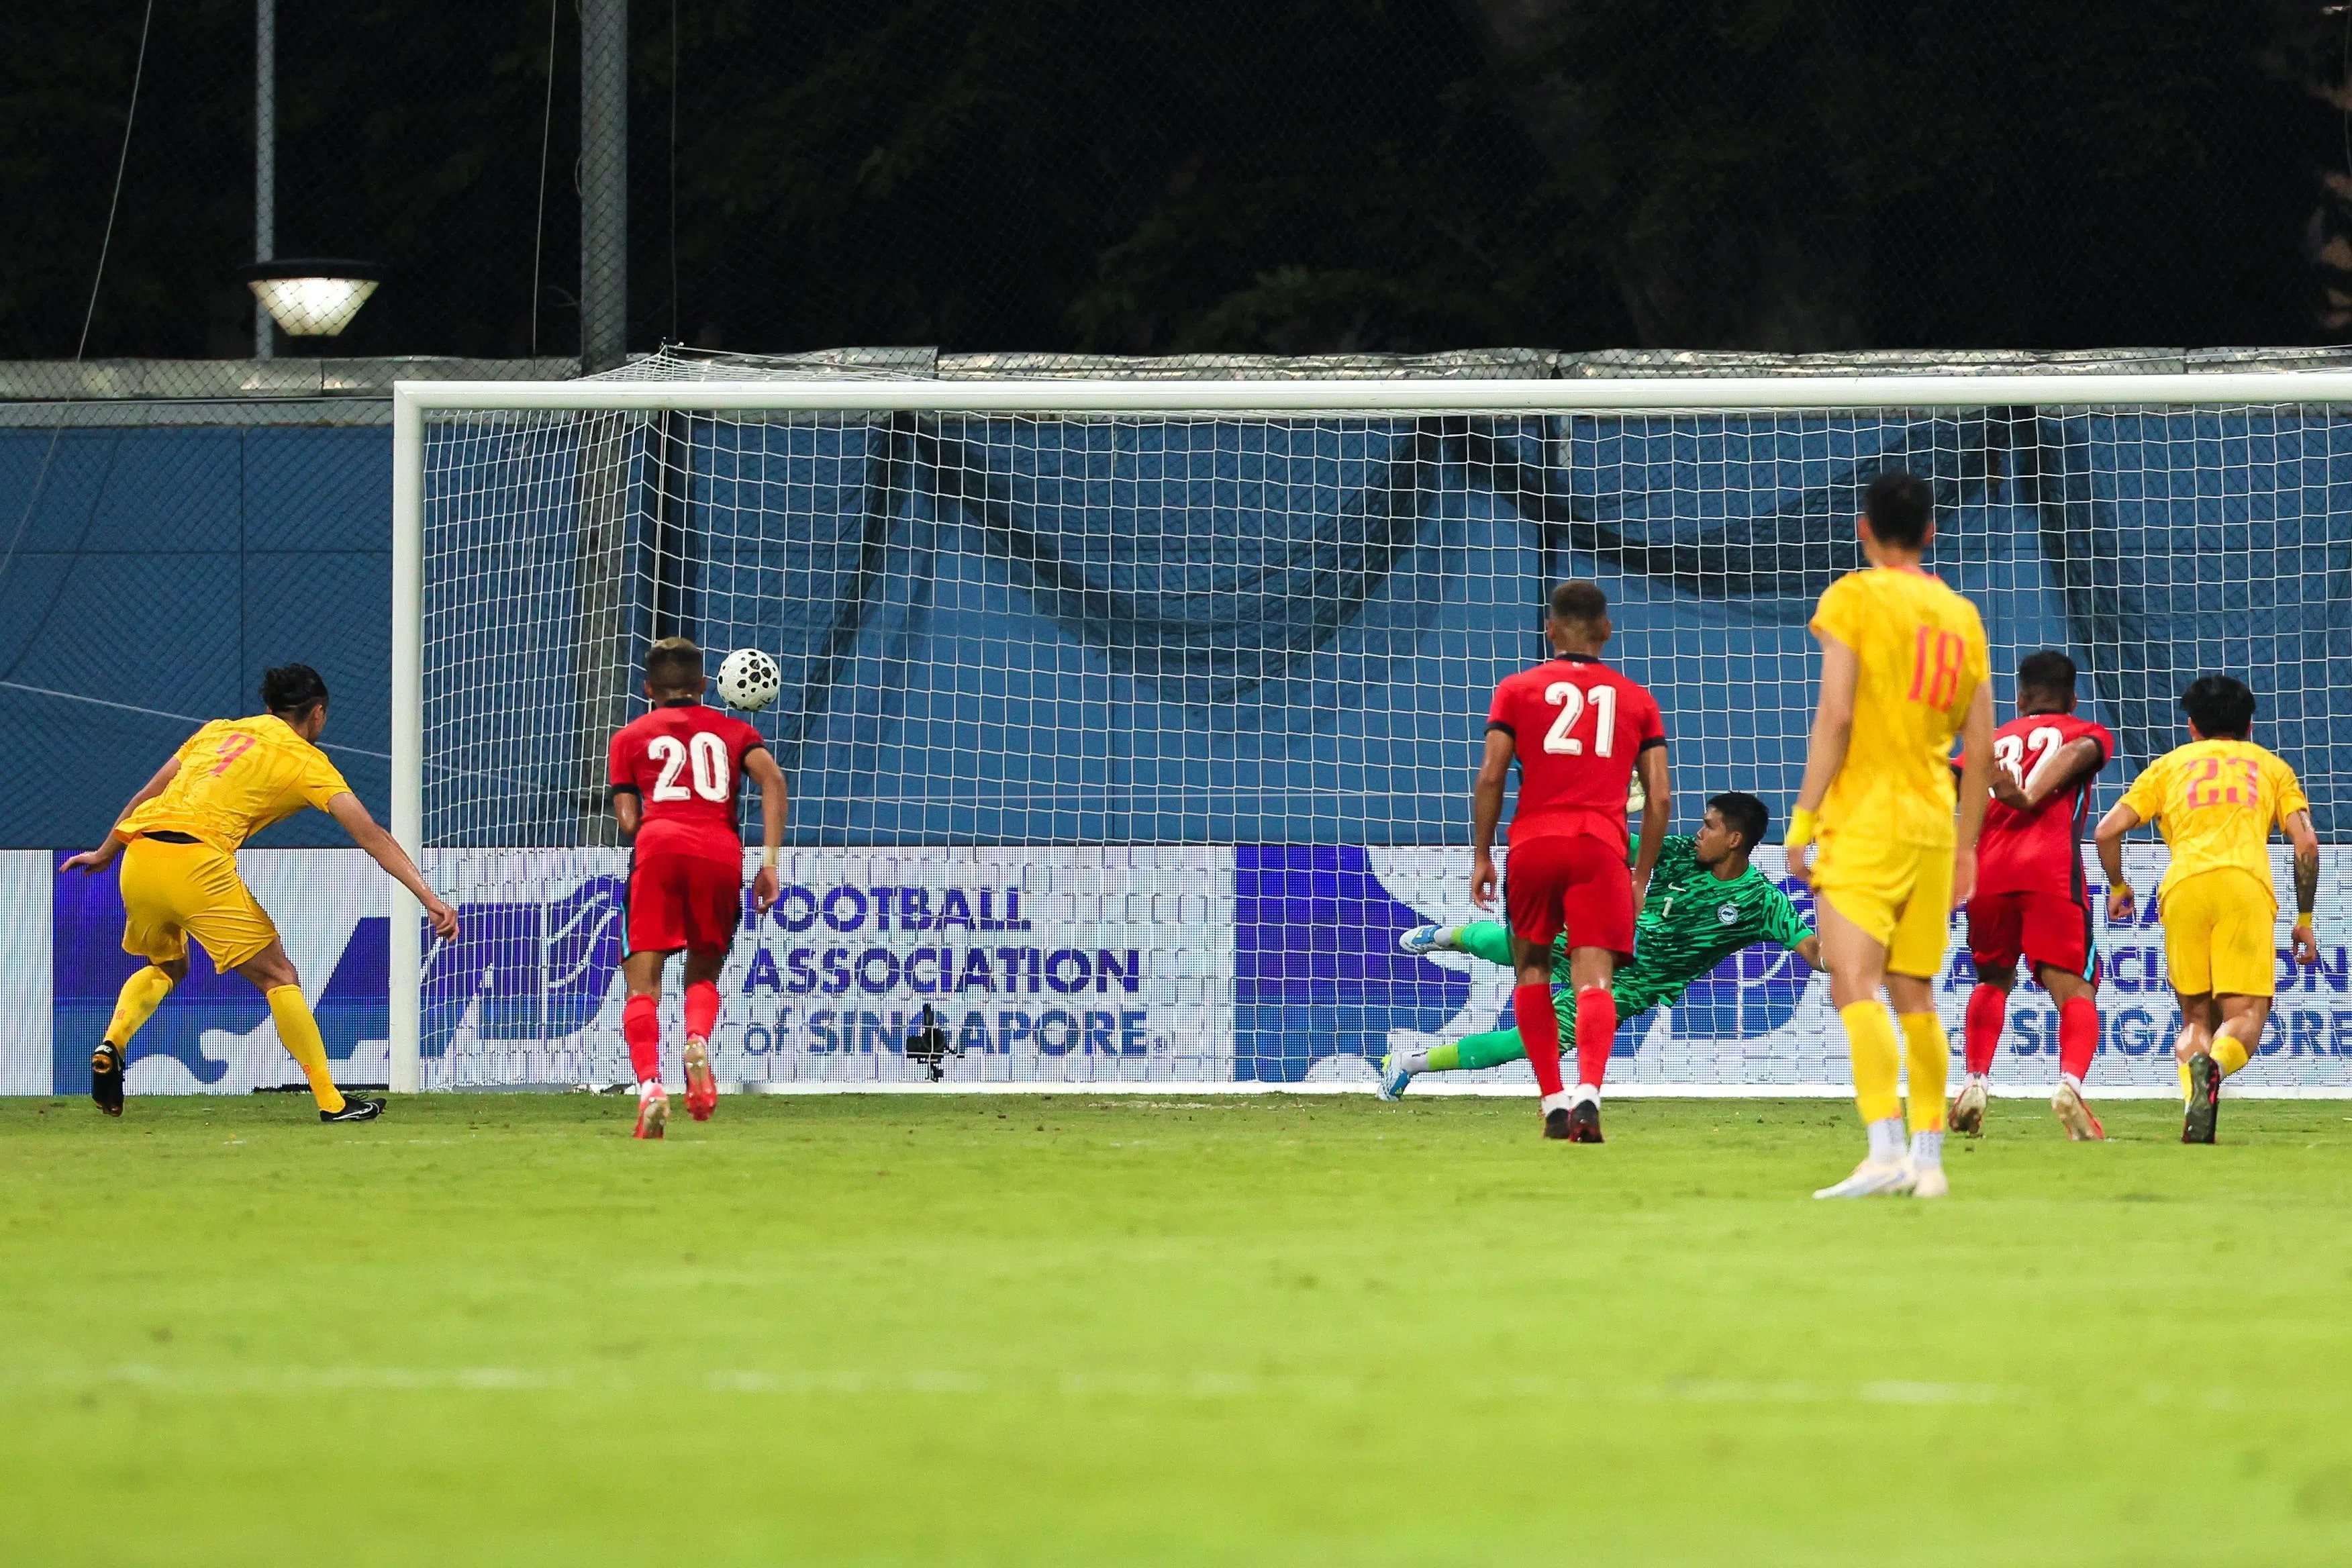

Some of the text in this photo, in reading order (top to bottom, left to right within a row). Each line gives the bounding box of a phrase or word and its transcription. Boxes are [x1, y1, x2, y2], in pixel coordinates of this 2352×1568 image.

[1906, 624, 1965, 713] 18
[1543, 681, 1616, 758] 21
[648, 732, 730, 803] 20
[1994, 727, 2063, 791] 32
[2186, 757, 2259, 810] 23
[1661, 896, 1674, 918] 1
[743, 948, 1139, 993] ASSOCIATION
[745, 1008, 791, 1055] of
